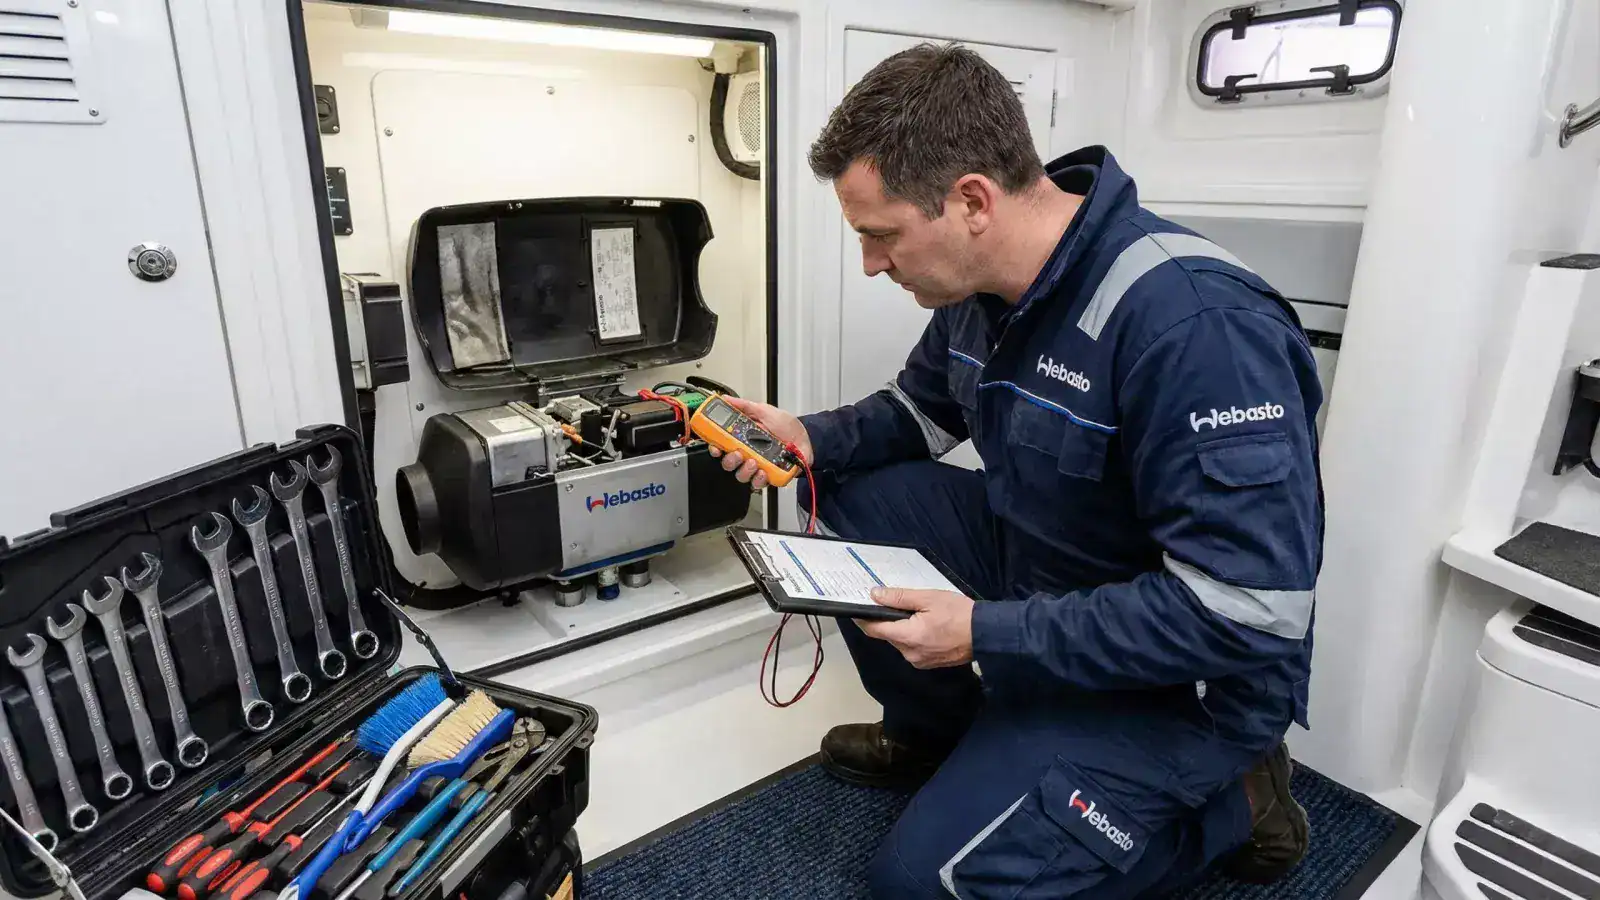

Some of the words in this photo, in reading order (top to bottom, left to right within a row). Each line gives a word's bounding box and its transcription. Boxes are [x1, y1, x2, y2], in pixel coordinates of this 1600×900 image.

[1036, 354, 1091, 393] Webasto
[1190, 402, 1285, 432] Webasto
[586, 482, 666, 513] Webasto
[1068, 788, 1134, 851] Webasto
